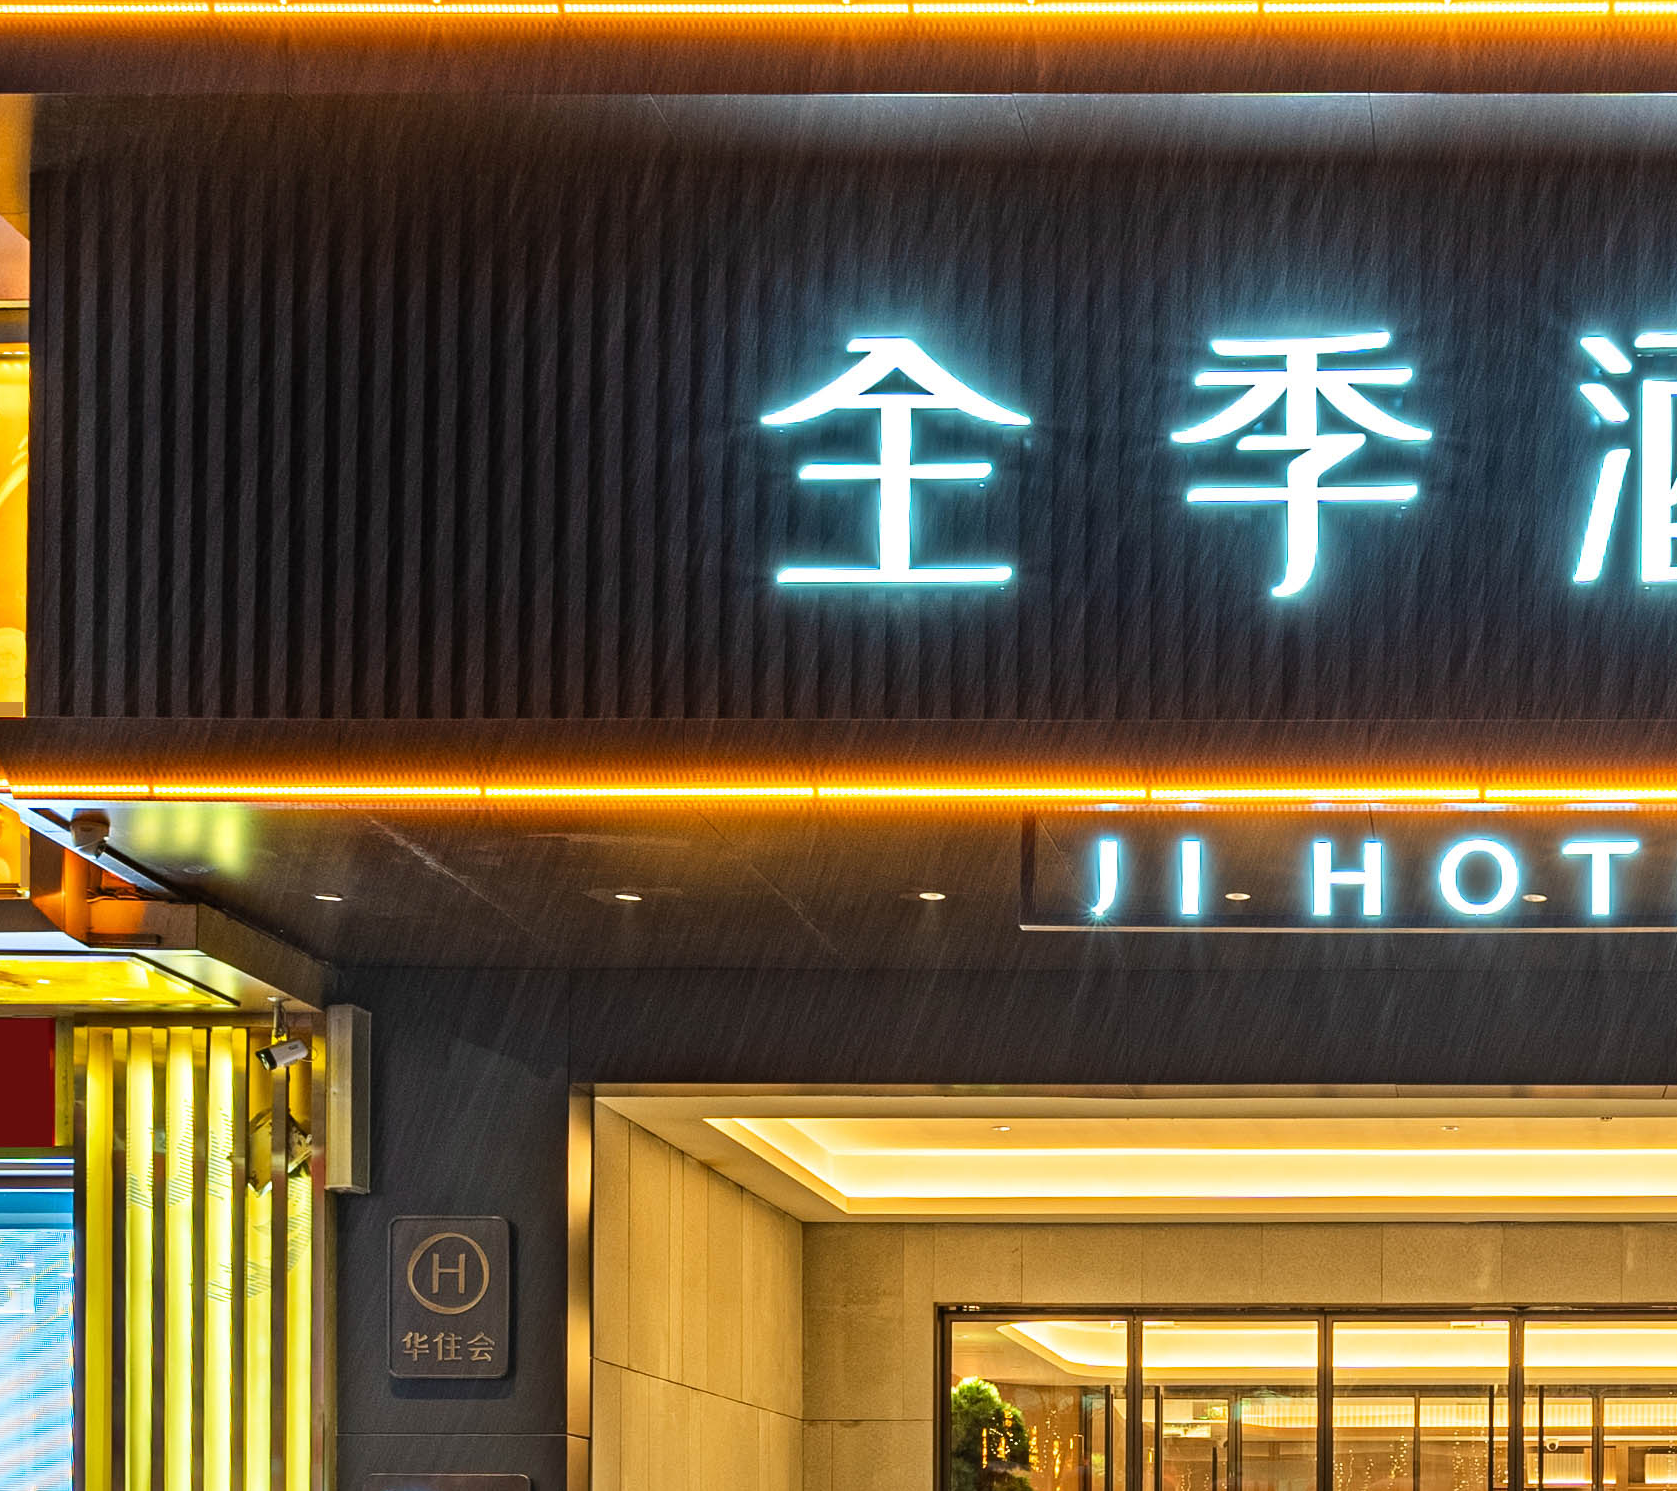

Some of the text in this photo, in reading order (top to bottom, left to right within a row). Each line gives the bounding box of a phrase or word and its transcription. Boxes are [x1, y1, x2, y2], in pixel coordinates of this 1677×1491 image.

[1091, 839, 1201, 916] JI
[401, 1331, 495, 1362] 华住会
